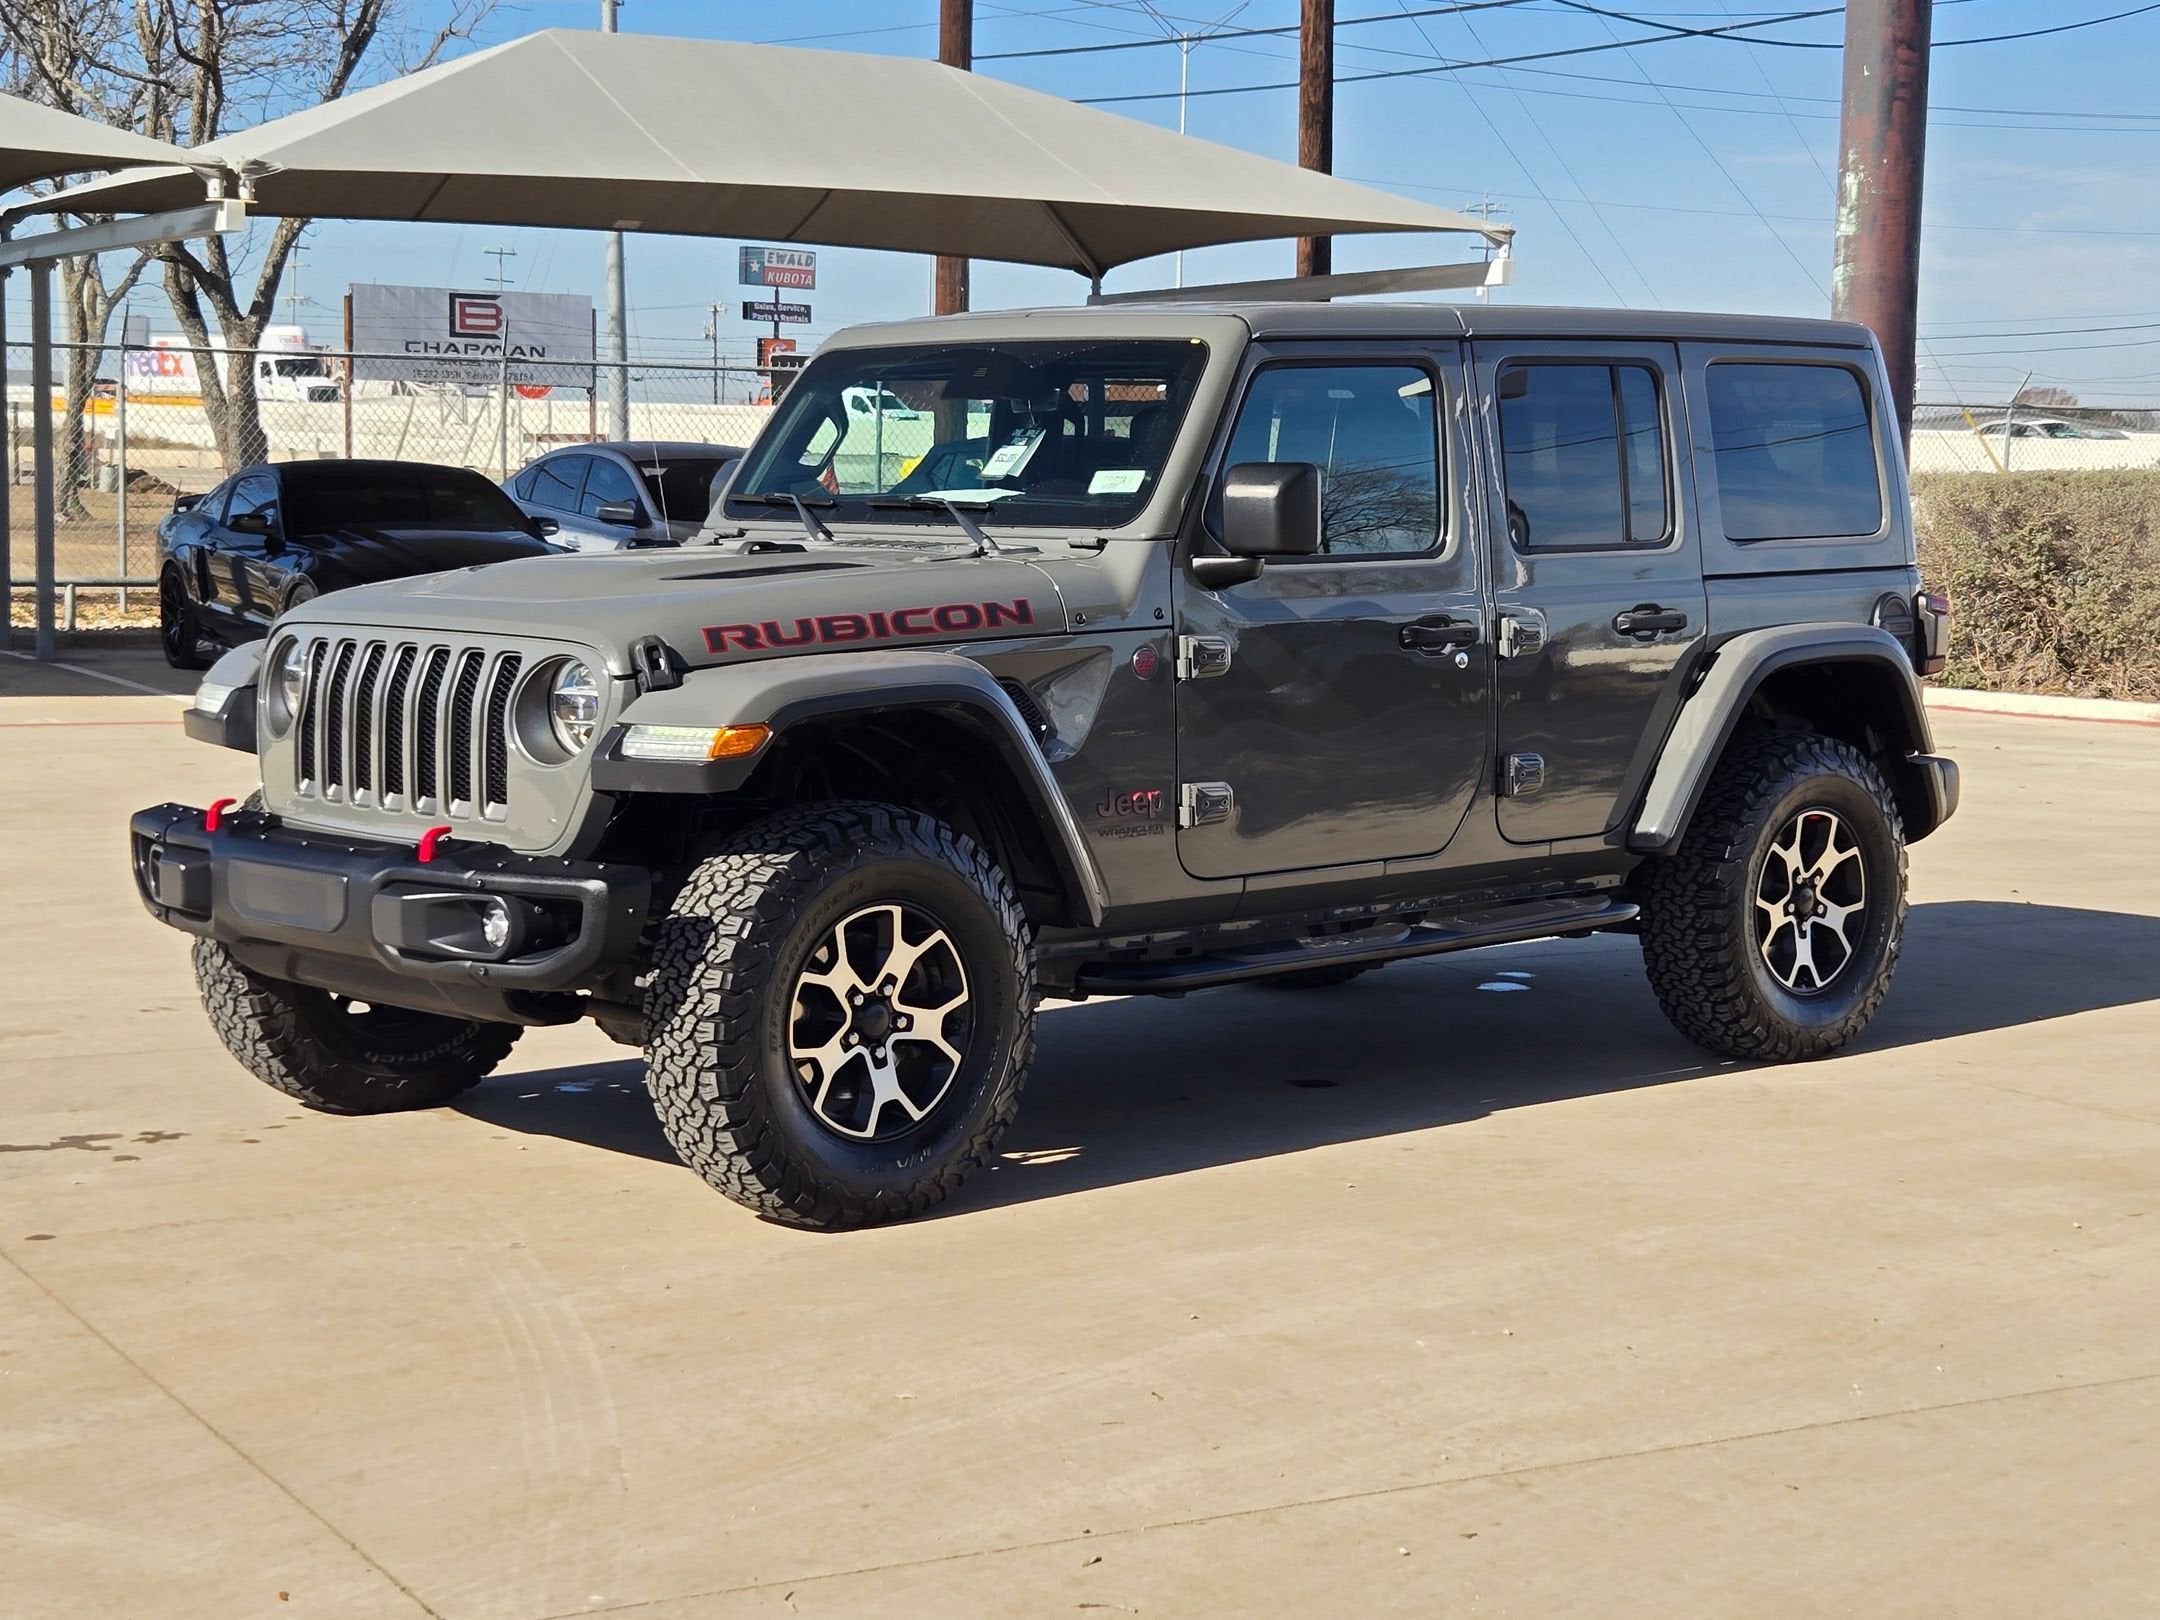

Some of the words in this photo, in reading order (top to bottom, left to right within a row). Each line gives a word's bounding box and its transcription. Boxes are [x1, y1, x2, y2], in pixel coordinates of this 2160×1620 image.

[767, 252, 814, 267] EWALD
[767, 272, 813, 286] KUBOTA
[752, 312, 772, 321] Parts
[404, 341, 546, 358] CHAPMAN
[702, 598, 1035, 654] RUBICON
[1096, 788, 1163, 819] Jeep
[1098, 823, 1165, 838] WRANGLER
